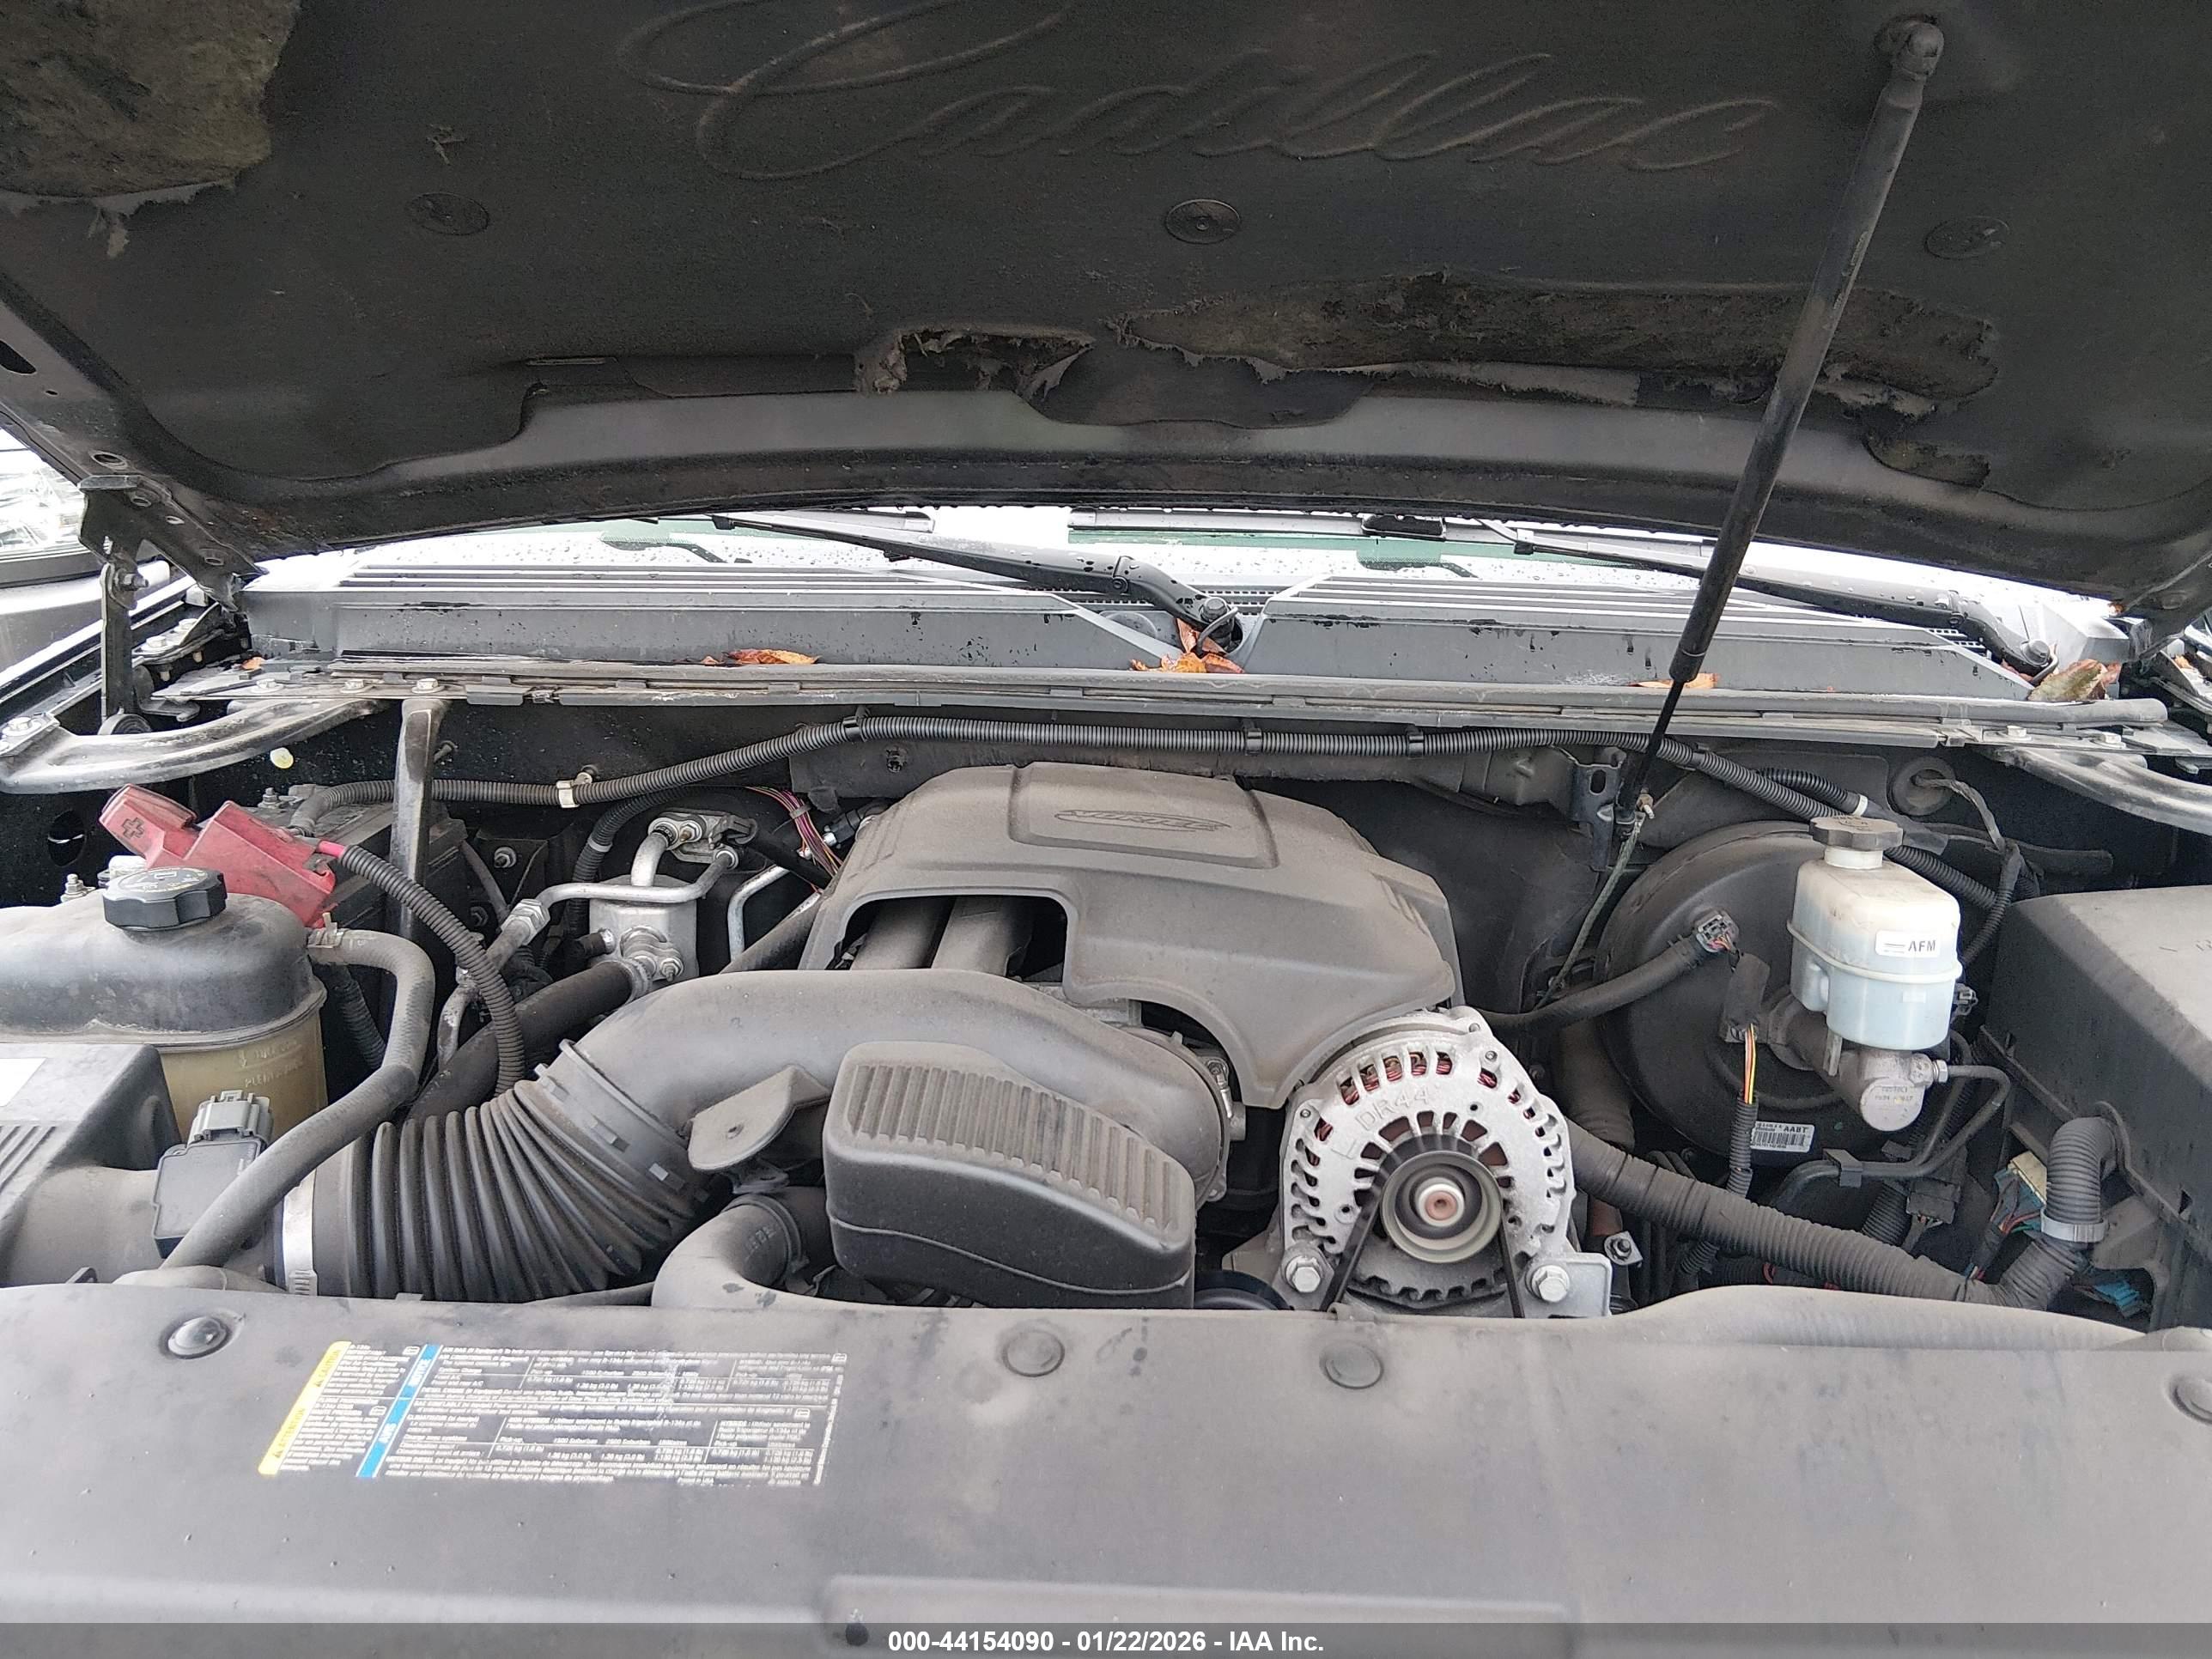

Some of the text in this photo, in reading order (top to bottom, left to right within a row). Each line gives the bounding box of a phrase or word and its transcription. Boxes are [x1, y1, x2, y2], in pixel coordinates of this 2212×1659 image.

[617, 0, 1783, 182] Cadillac
[1908, 940, 1936, 951] AFM
[1354, 1084, 1430, 1132] DR44
